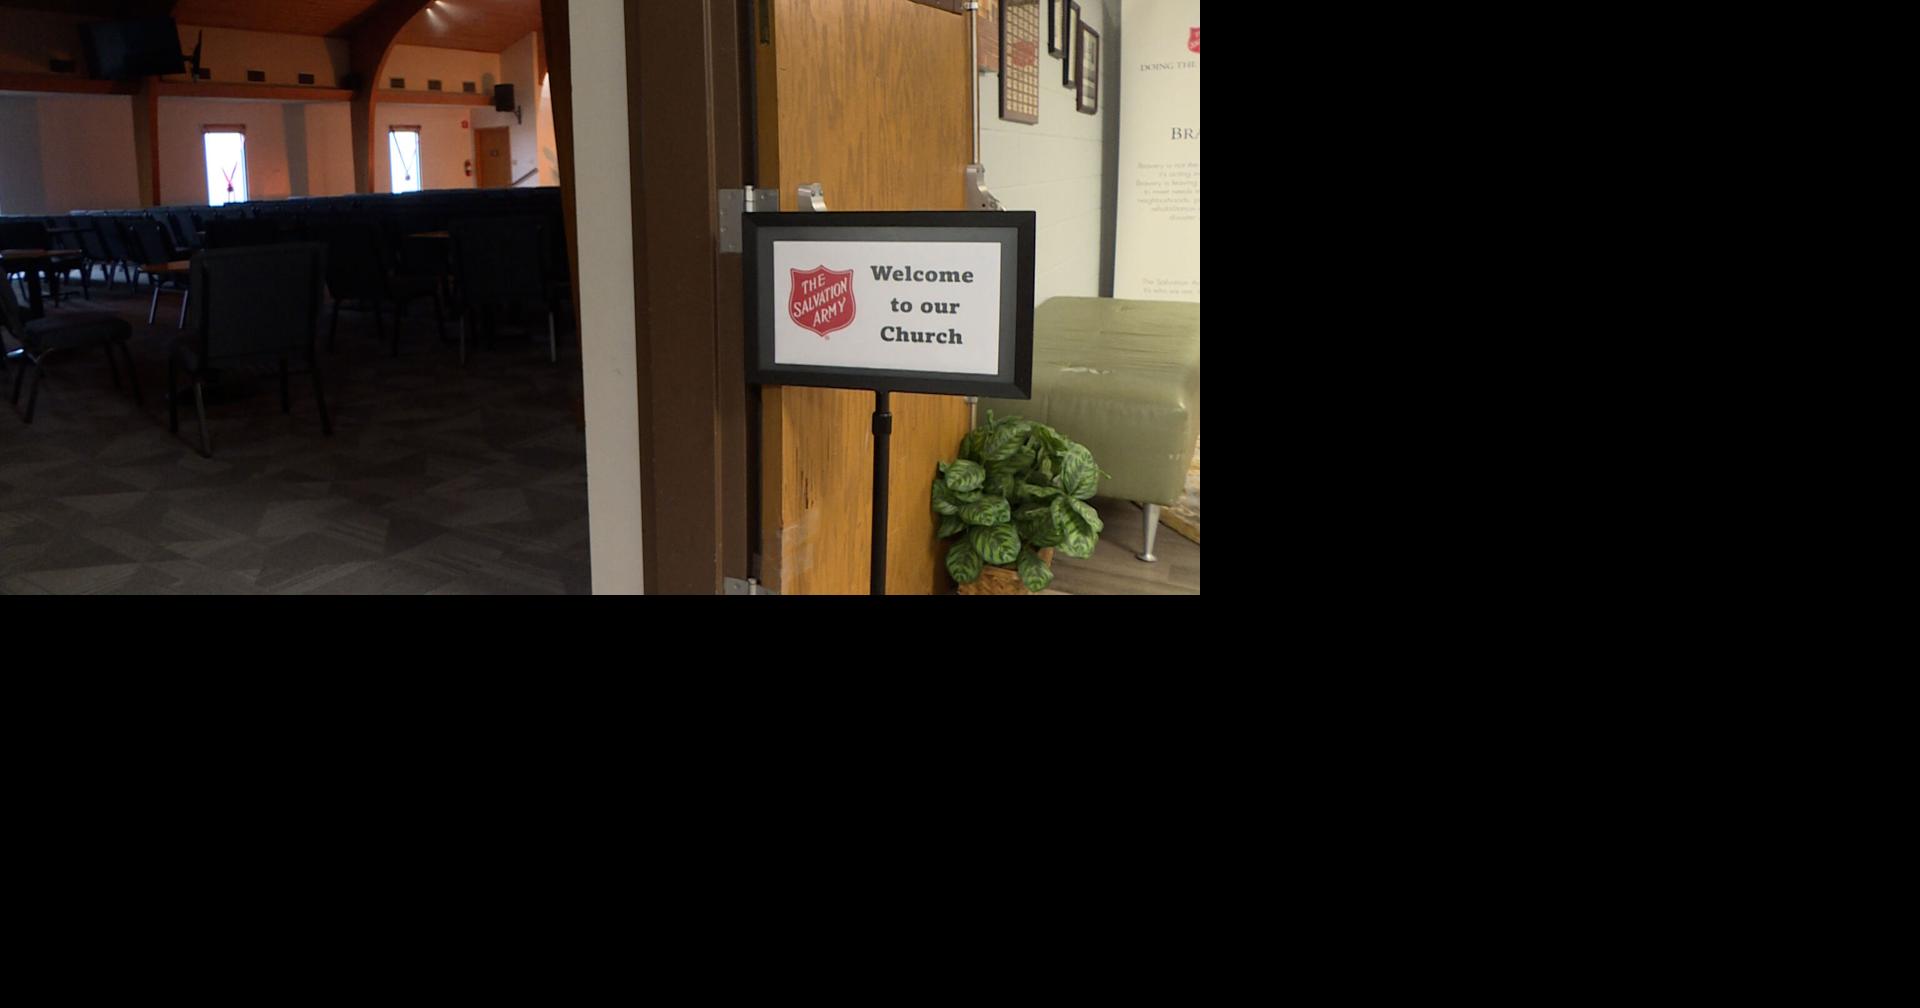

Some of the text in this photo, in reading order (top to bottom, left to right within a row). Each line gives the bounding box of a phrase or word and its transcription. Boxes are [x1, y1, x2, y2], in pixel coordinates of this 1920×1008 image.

[1140, 61, 1195, 72] DOING THE
[801, 273, 826, 295] THE
[870, 265, 974, 283] Welcome
[793, 277, 848, 318] SALVATION
[890, 297, 961, 315] to our
[813, 297, 847, 327] ARMY
[880, 325, 963, 345] Church
